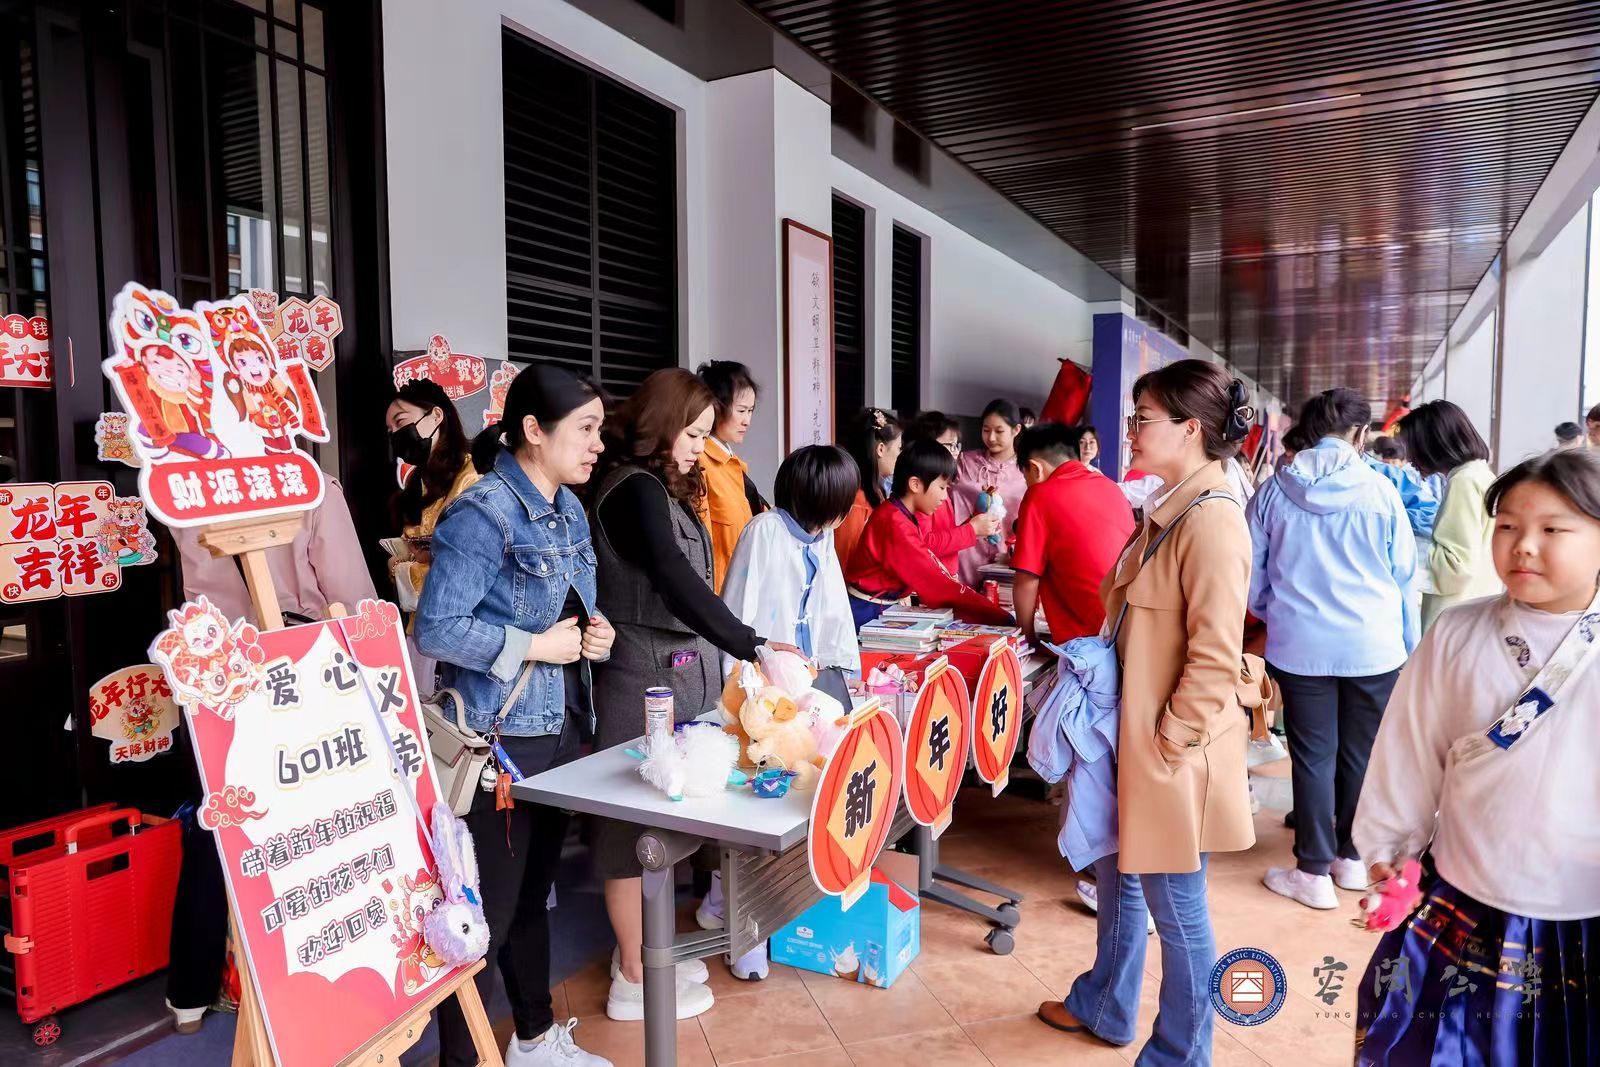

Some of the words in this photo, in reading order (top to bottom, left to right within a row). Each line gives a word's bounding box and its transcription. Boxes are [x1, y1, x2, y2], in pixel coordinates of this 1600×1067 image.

[0, 319, 48, 337] 有钱
[287, 306, 335, 334] 龙年
[277, 335, 327, 362] 新春
[98, 488, 108, 499] 年
[167, 464, 308, 510] 财源滚滚
[10, 494, 97, 540] 龙年
[7, 585, 20, 597] 快
[104, 575, 115, 587] 乐
[13, 541, 103, 591] 吉祥
[115, 736, 170, 761] 天降财神
[278, 727, 368, 784] 601班
[844, 759, 877, 838] 新
[929, 715, 951, 771] 年
[991, 685, 1008, 742] 好
[241, 790, 396, 876] 带着新年的祝福
[262, 846, 394, 932] 可爱的孩子们
[299, 897, 387, 964] 欢迎回家
